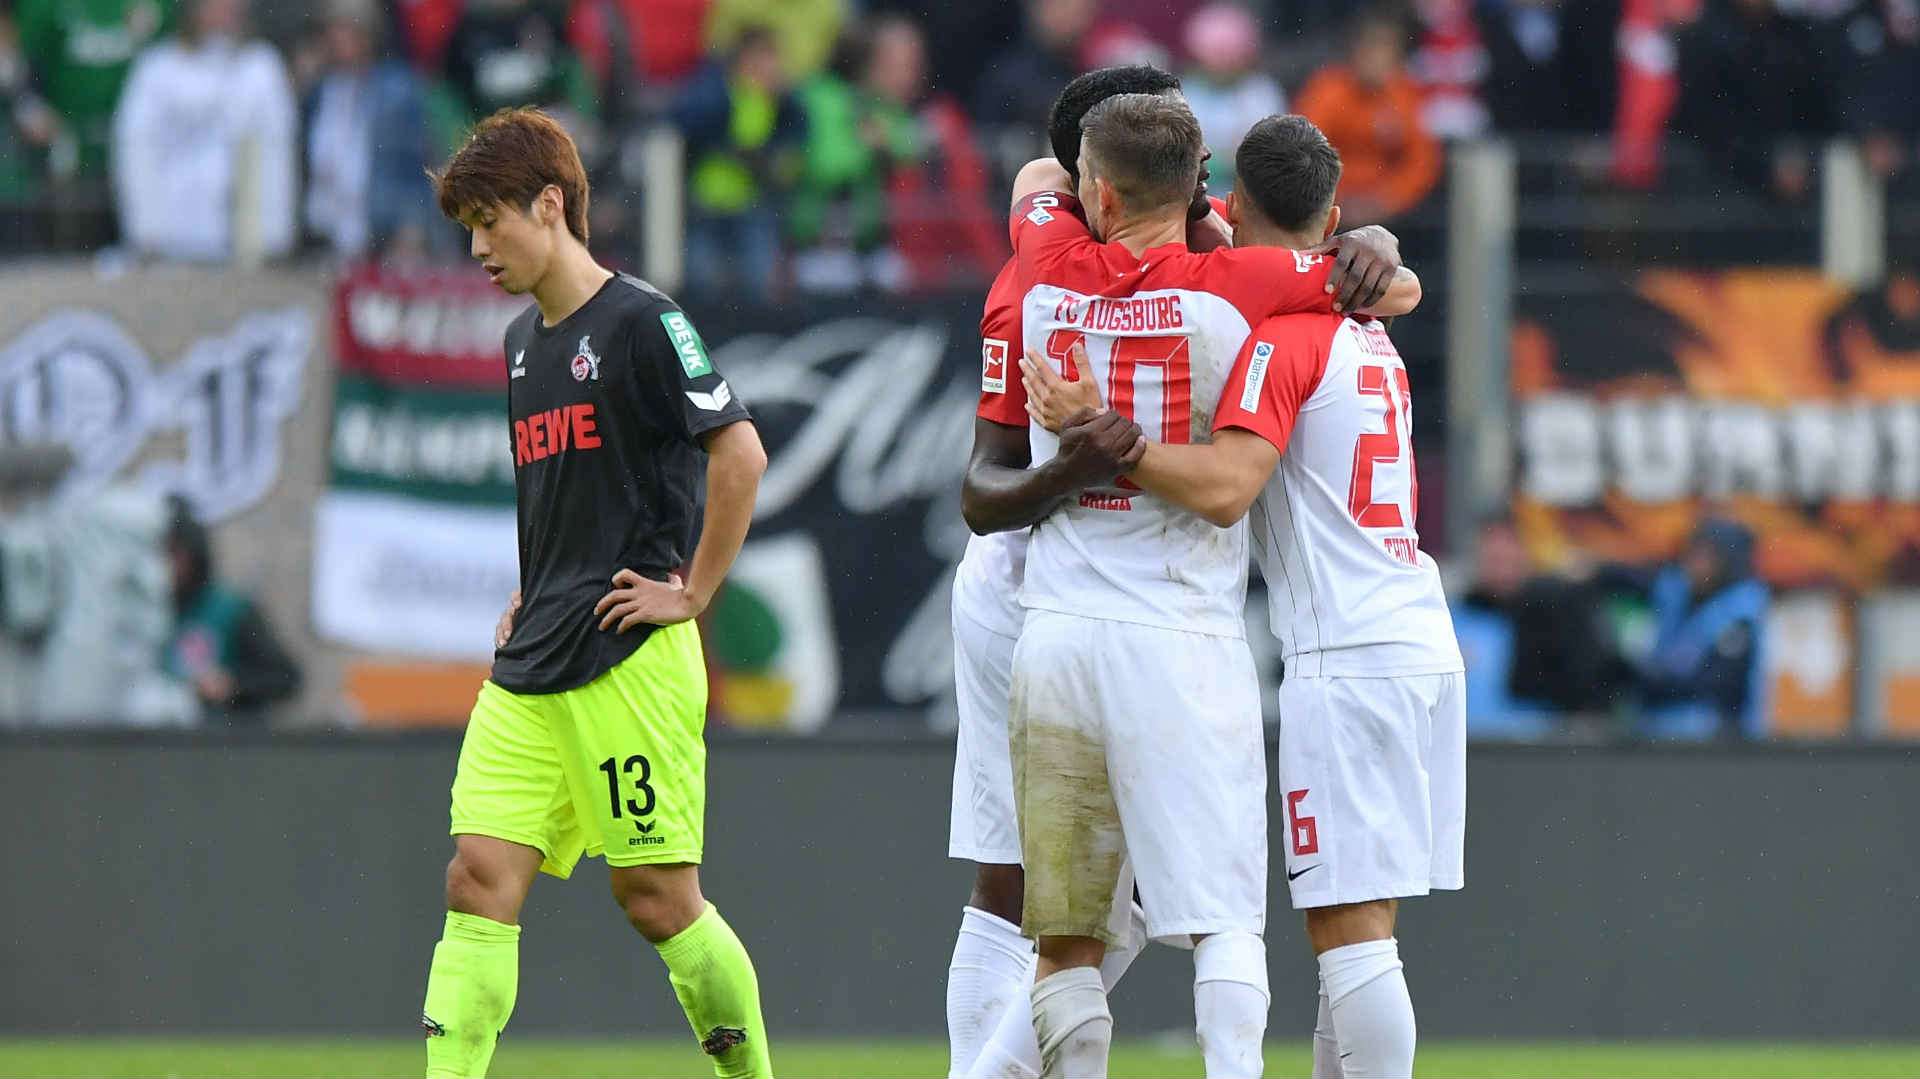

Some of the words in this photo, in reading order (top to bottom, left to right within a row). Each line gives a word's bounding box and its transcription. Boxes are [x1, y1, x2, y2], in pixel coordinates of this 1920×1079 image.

[1055, 294, 1080, 324] FC
[1082, 295, 1183, 331] AUGSBURG
[667, 316, 705, 371] DEVK
[514, 404, 601, 466] REWE
[599, 754, 656, 818] 13
[628, 834, 665, 846] erima
[1287, 788, 1319, 856] 6
